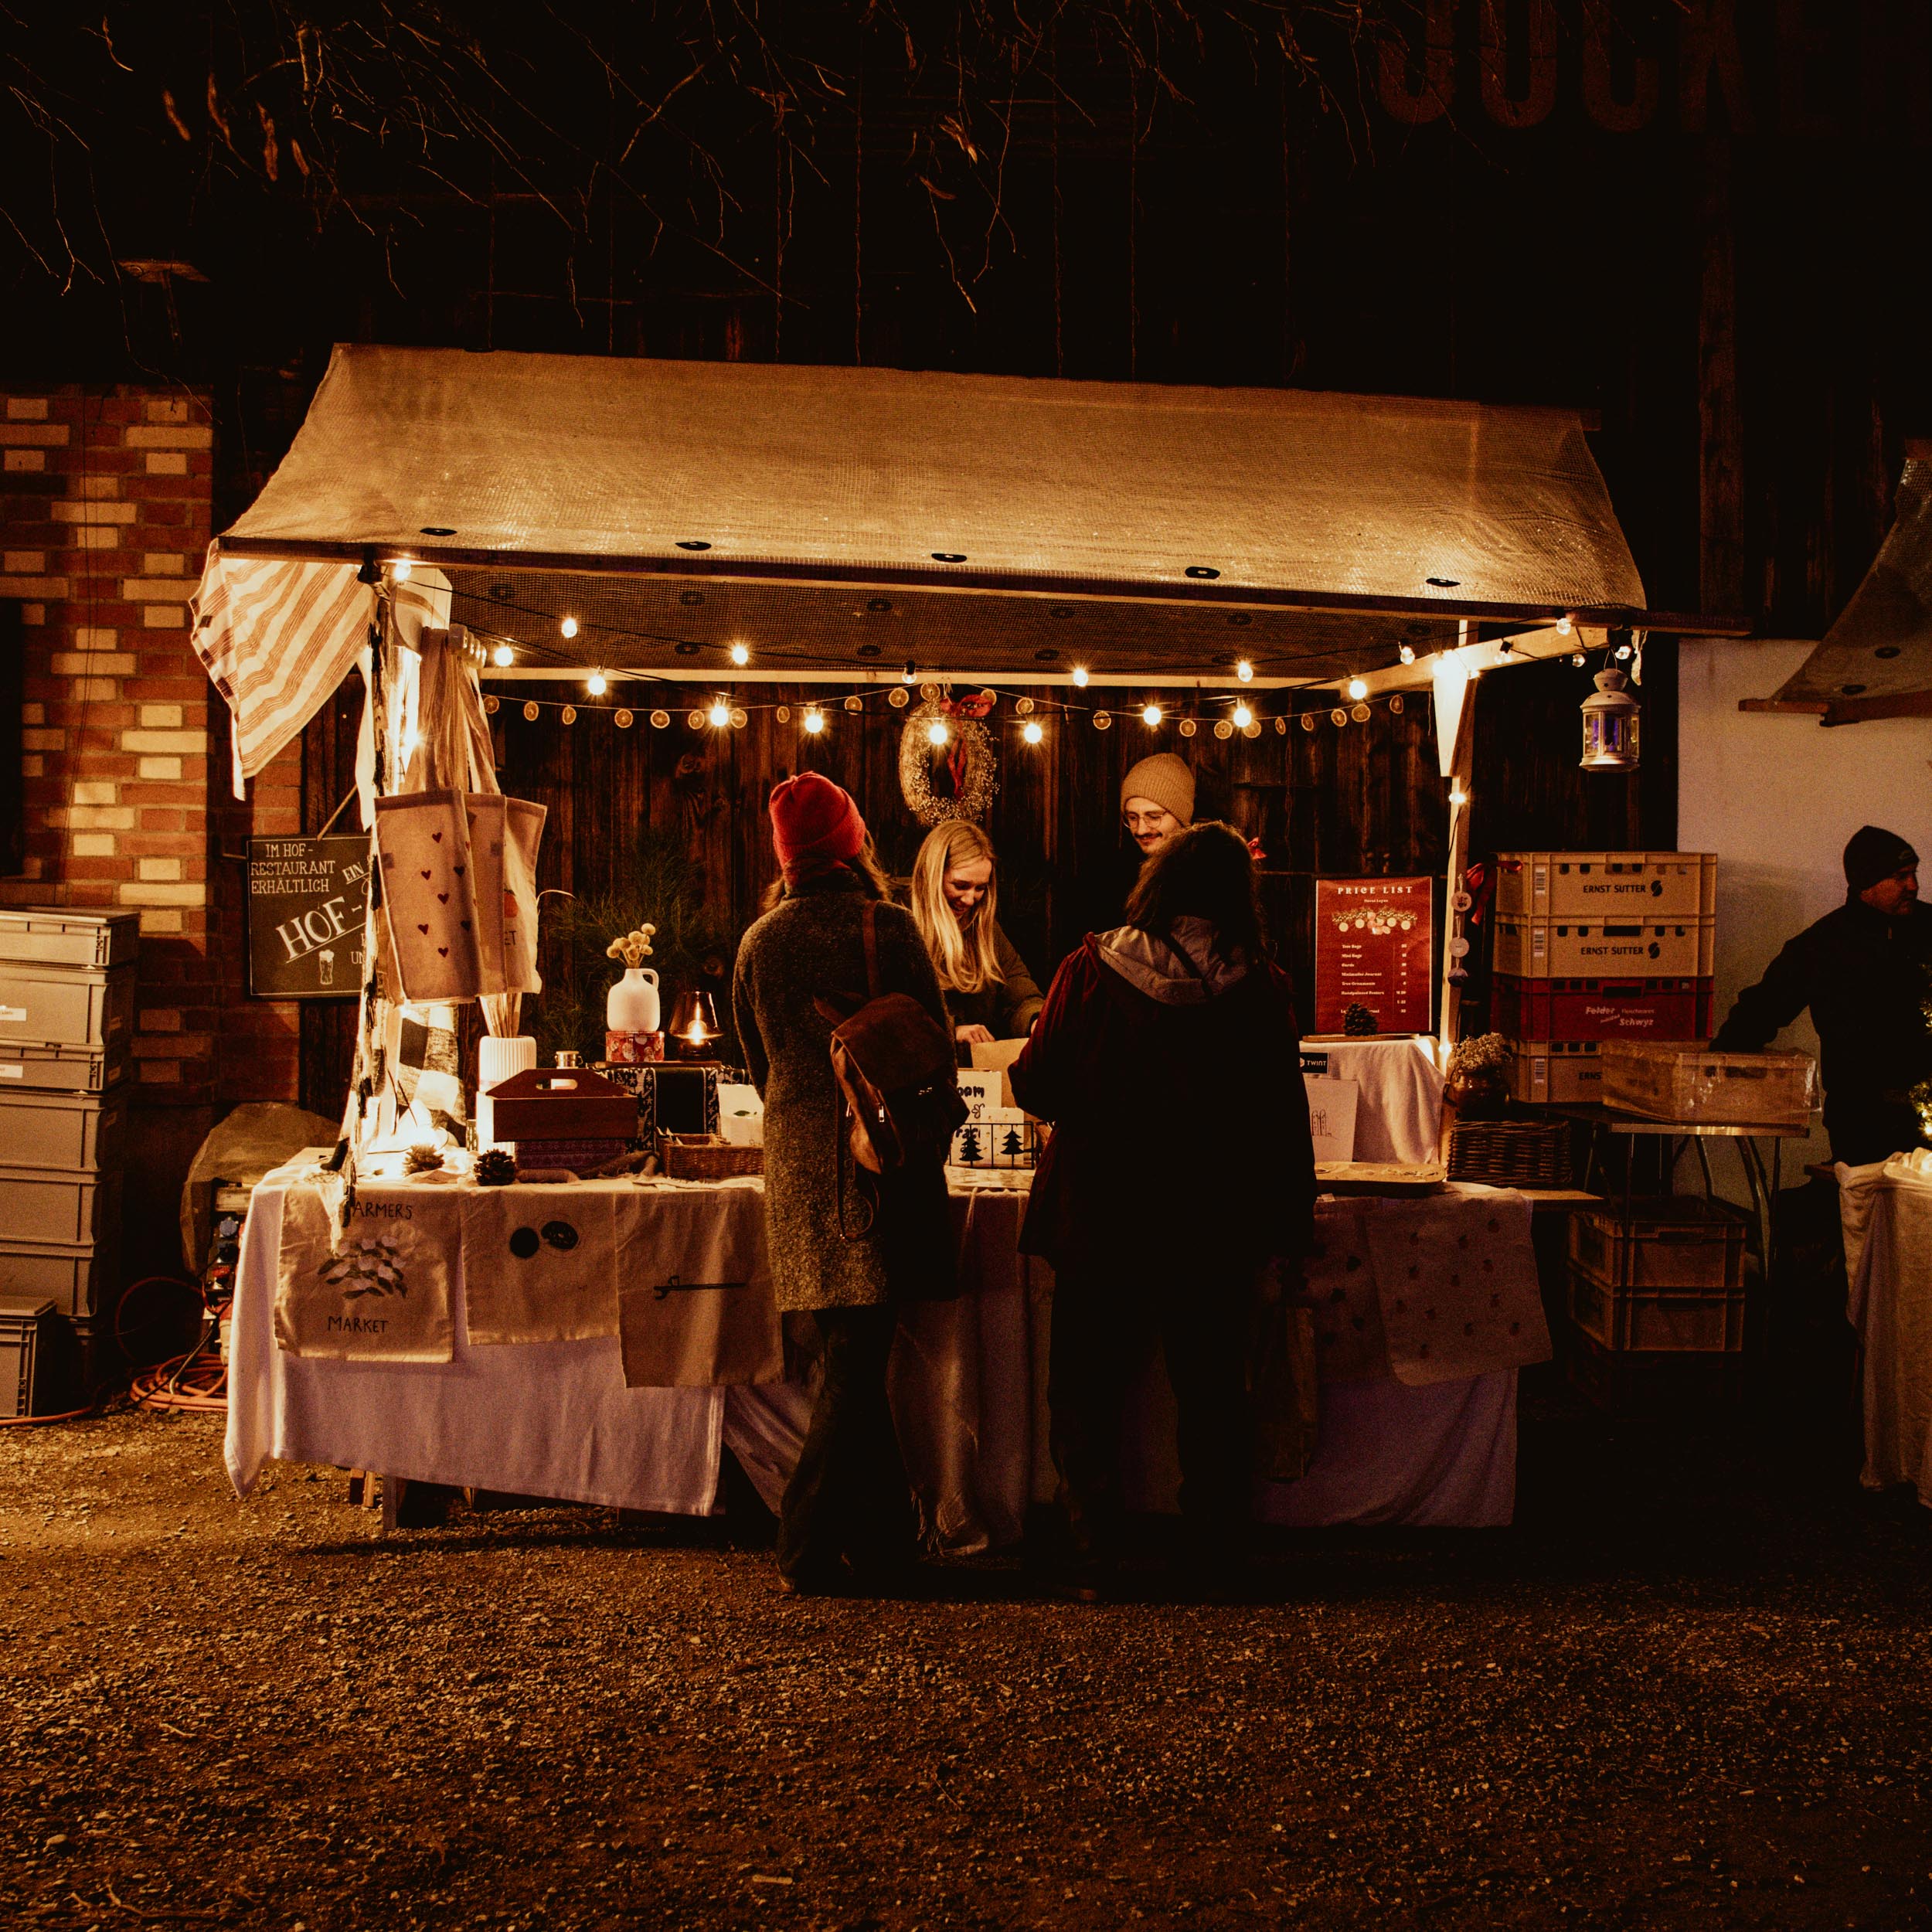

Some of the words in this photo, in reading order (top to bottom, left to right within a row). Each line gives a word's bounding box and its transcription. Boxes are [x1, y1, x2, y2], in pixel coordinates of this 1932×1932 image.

[265, 844, 280, 858] IM
[283, 843, 314, 857] HOF-
[250, 860, 335, 876] RESTAURANT
[342, 862, 365, 882] EIN
[251, 878, 330, 894] ERHÄLTLICH
[1337, 886, 1376, 895] PRICE
[1383, 886, 1413, 894] LIST
[1583, 885, 1611, 893] ERNST
[1614, 885, 1646, 893] SUTTER
[1580, 947, 1608, 955] ERNST
[1611, 947, 1644, 955] SUTTER
[1585, 1005, 1615, 1015] Felder
[1619, 1017, 1654, 1028] Schwyz
[352, 1202, 413, 1220] ARMERS
[327, 1316, 389, 1333] MARKET
